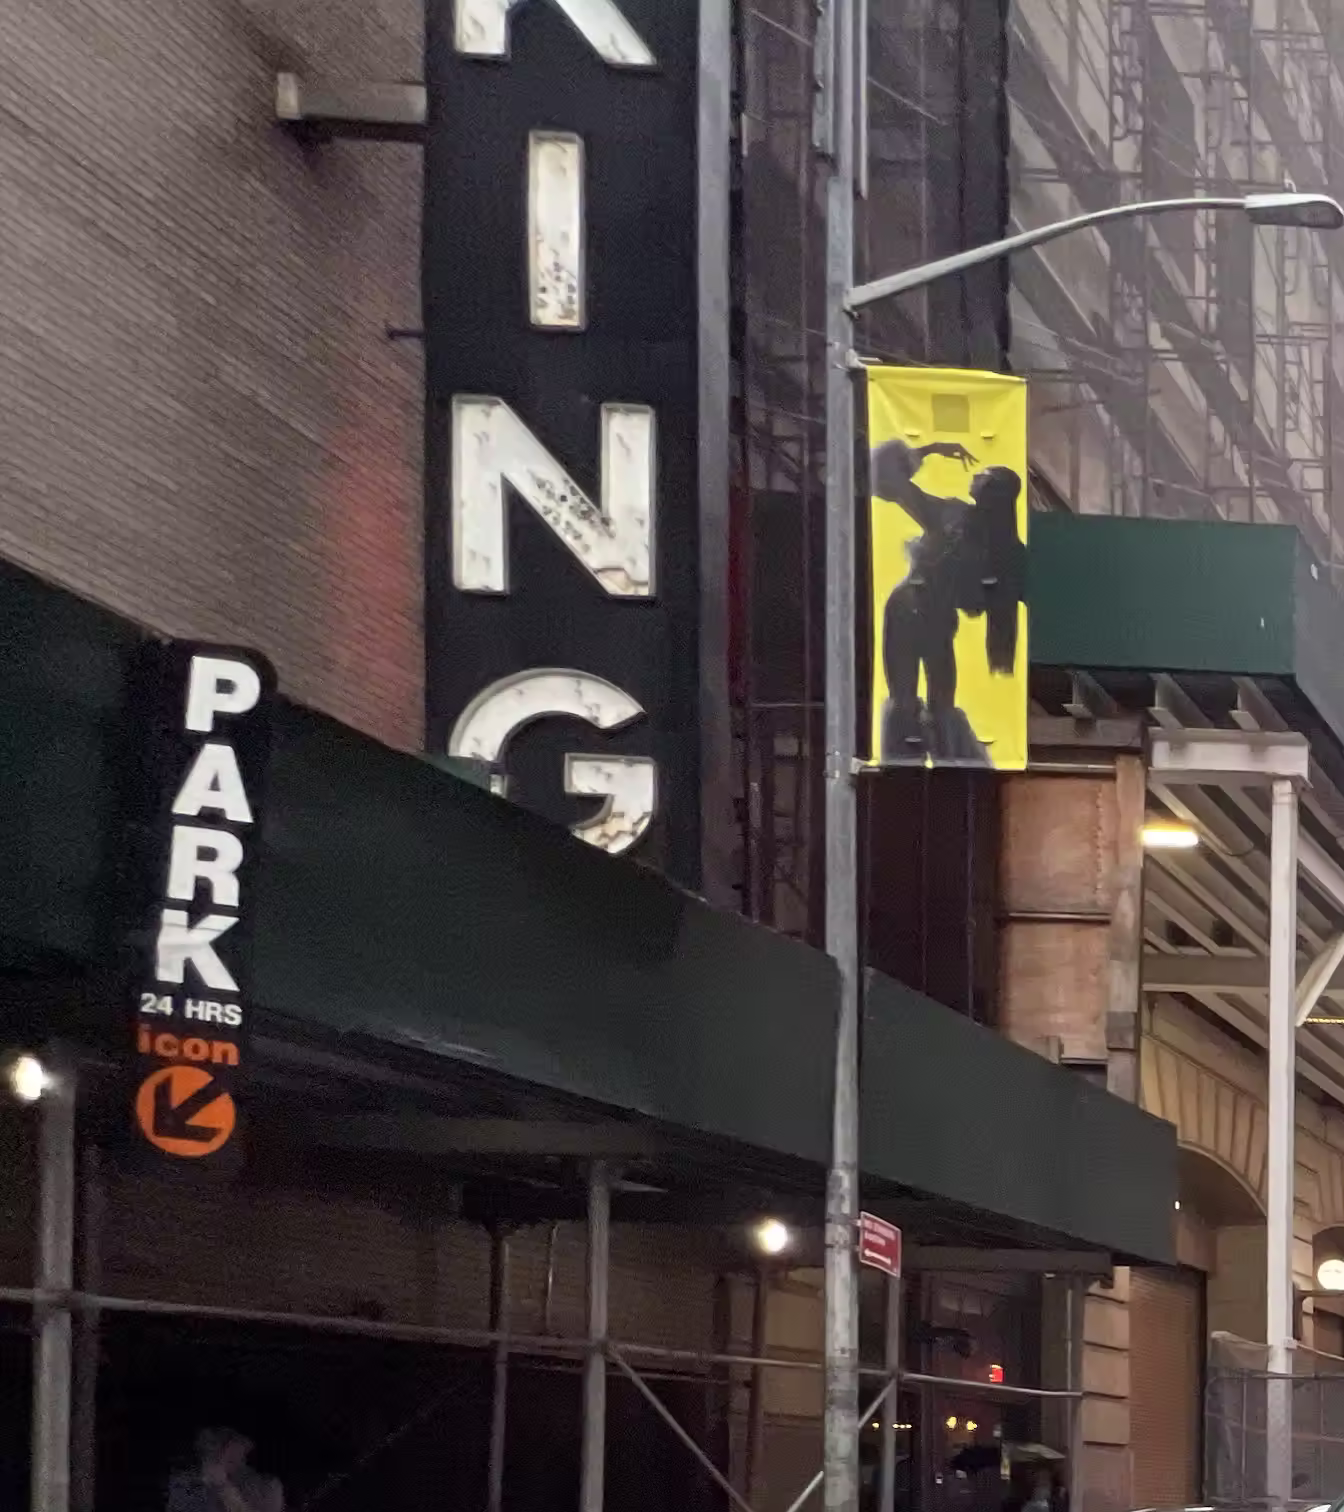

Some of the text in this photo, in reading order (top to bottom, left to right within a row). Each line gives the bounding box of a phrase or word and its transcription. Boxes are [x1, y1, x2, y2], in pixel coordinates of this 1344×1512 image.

[449, 0, 658, 854] ING
[155, 655, 260, 993] PARK
[138, 1023, 241, 1066] icon
[140, 992, 242, 1026] 24 HRS
